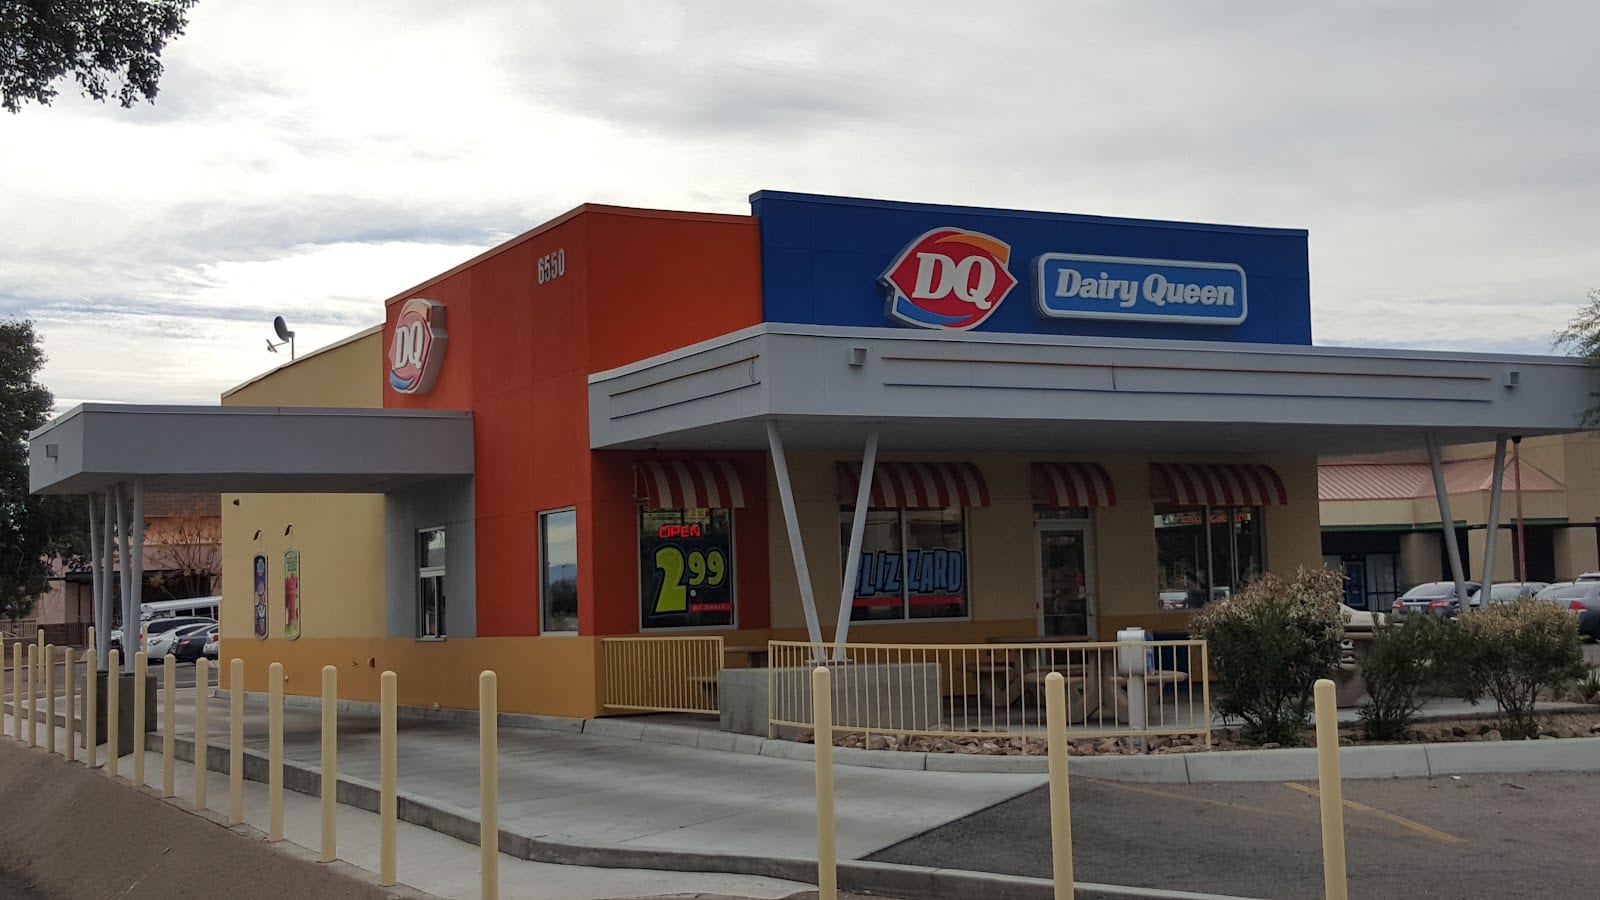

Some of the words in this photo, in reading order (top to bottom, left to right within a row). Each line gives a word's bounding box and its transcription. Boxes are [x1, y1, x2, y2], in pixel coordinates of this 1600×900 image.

[538, 248, 565, 285] 6550
[911, 252, 996, 310] DQ
[1055, 268, 1139, 308] Dairy
[1142, 273, 1235, 307] Queen
[394, 321, 424, 369] DQ
[658, 525, 701, 538] OPEN
[855, 549, 963, 596] LIZZARD
